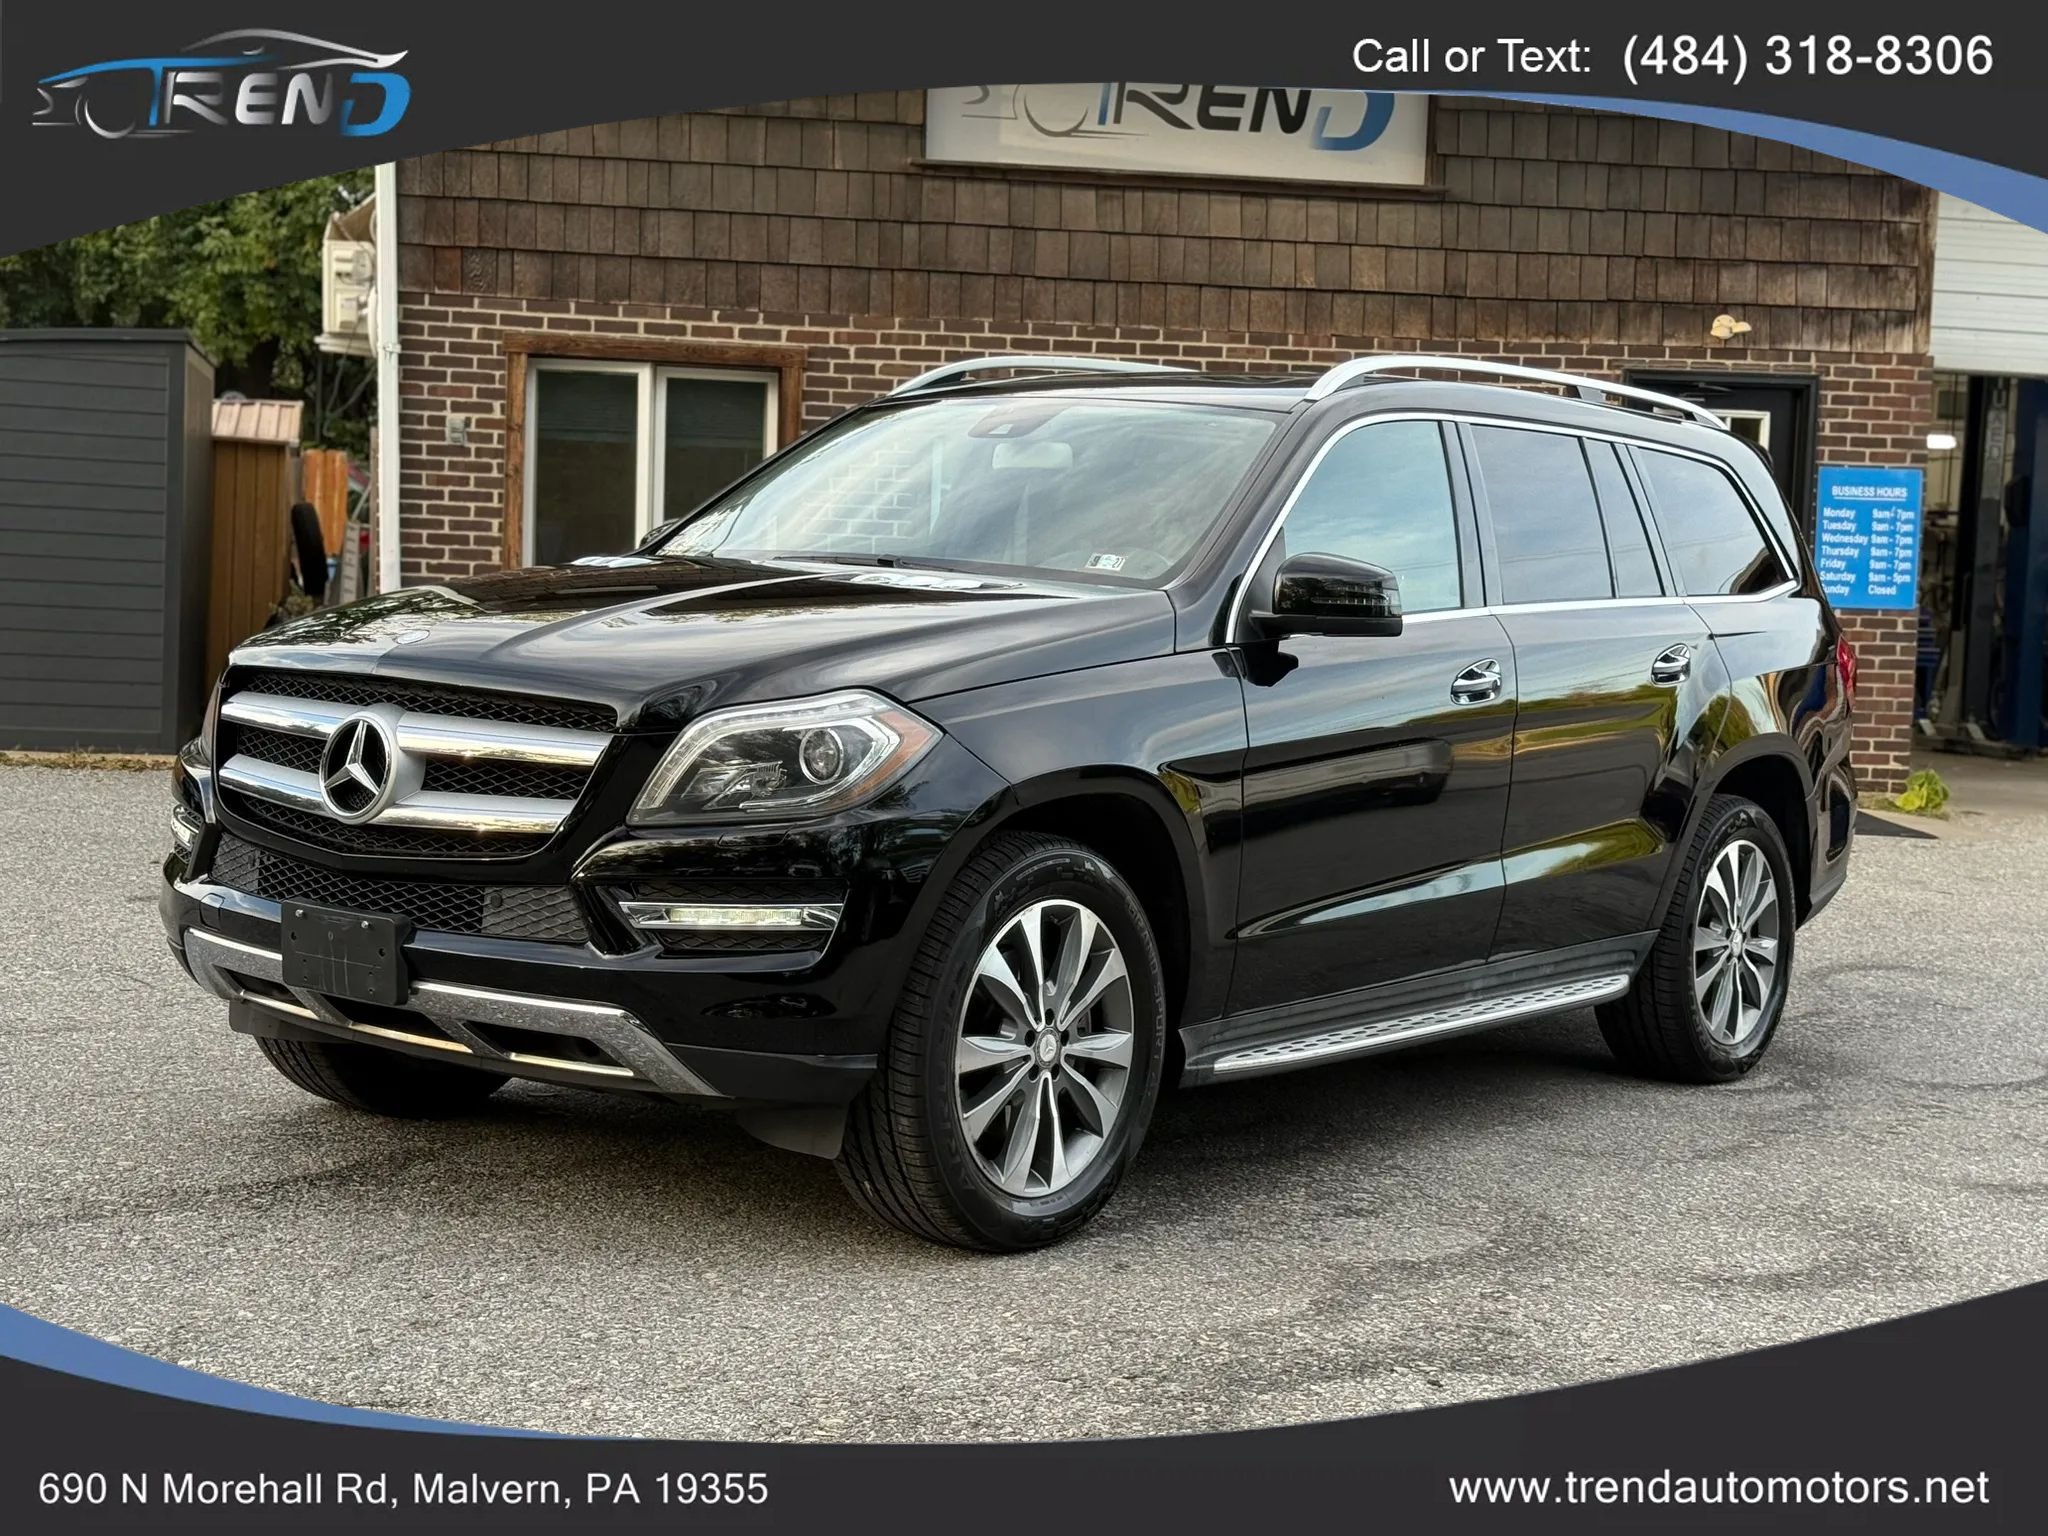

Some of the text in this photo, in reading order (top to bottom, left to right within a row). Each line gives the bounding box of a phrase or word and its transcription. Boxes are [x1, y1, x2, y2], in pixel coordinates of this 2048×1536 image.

[1832, 485, 1908, 498] BUSINESS HOURS
[1823, 507, 1856, 520] Monday
[1823, 520, 1857, 533] Tuesday
[1822, 533, 1869, 546] Wednesday
[1821, 545, 1860, 558] Thursday
[1820, 558, 1846, 571] Friday
[1820, 571, 1856, 584] Saturday
[1868, 585, 1897, 596] Closed
